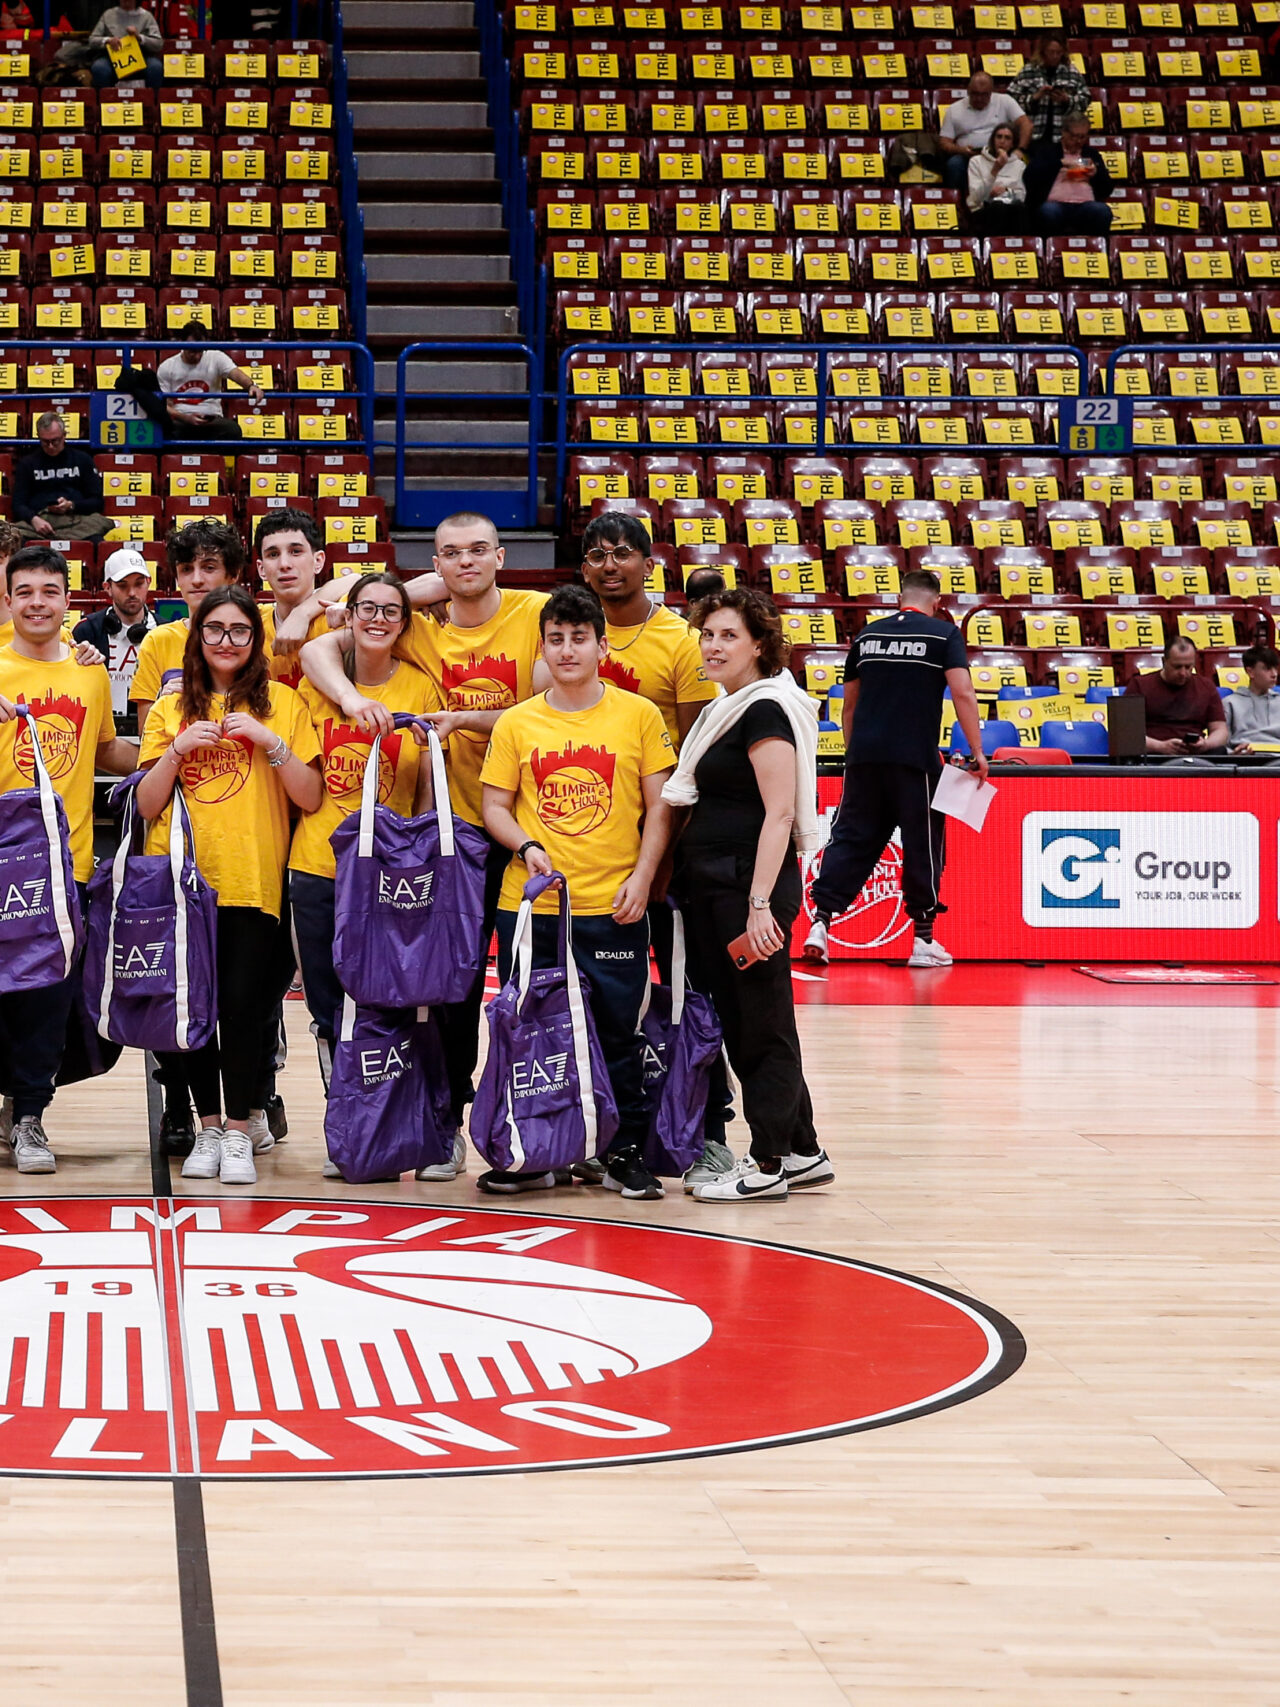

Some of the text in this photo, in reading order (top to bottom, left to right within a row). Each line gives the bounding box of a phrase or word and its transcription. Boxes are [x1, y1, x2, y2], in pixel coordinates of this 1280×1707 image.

[113, 398, 138, 416] 21
[1083, 402, 1111, 420] 22
[108, 432, 118, 443] B
[1077, 437, 1088, 448] B
[860, 641, 926, 656] MILANO
[21, 730, 71, 745] OIMPIA
[184, 762, 238, 786] SCHOOL
[541, 783, 595, 800] OLIMPIA
[540, 796, 599, 819] SCHOOL
[1135, 851, 1231, 888] Group
[379, 870, 434, 902] EA7
[1135, 891, 1162, 901] YOUR
[1188, 891, 1208, 901] OUR
[1210, 891, 1242, 901] WORK
[603, 951, 635, 960] GALDUS
[512, 1052, 569, 1090] EA7
[43, 1280, 298, 1299] 19 36
